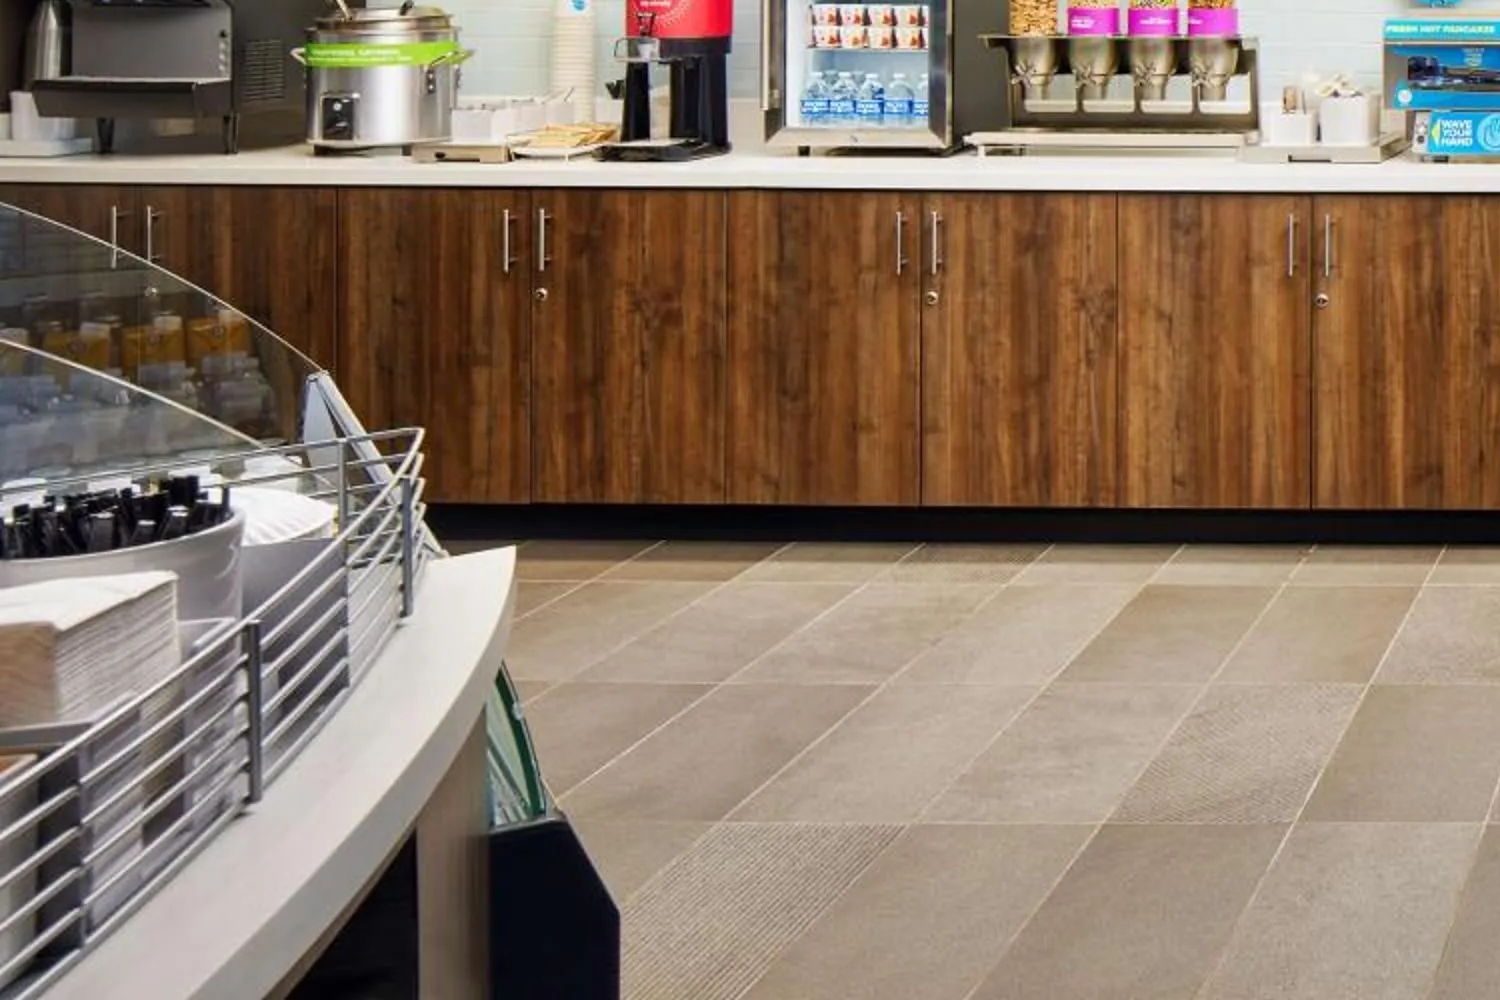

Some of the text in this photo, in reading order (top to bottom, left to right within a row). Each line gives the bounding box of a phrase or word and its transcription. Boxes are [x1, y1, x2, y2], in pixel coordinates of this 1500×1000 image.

[1440, 119, 1472, 129] WAVE
[1442, 129, 1473, 138] YOUR
[1440, 138, 1473, 147] HAND
